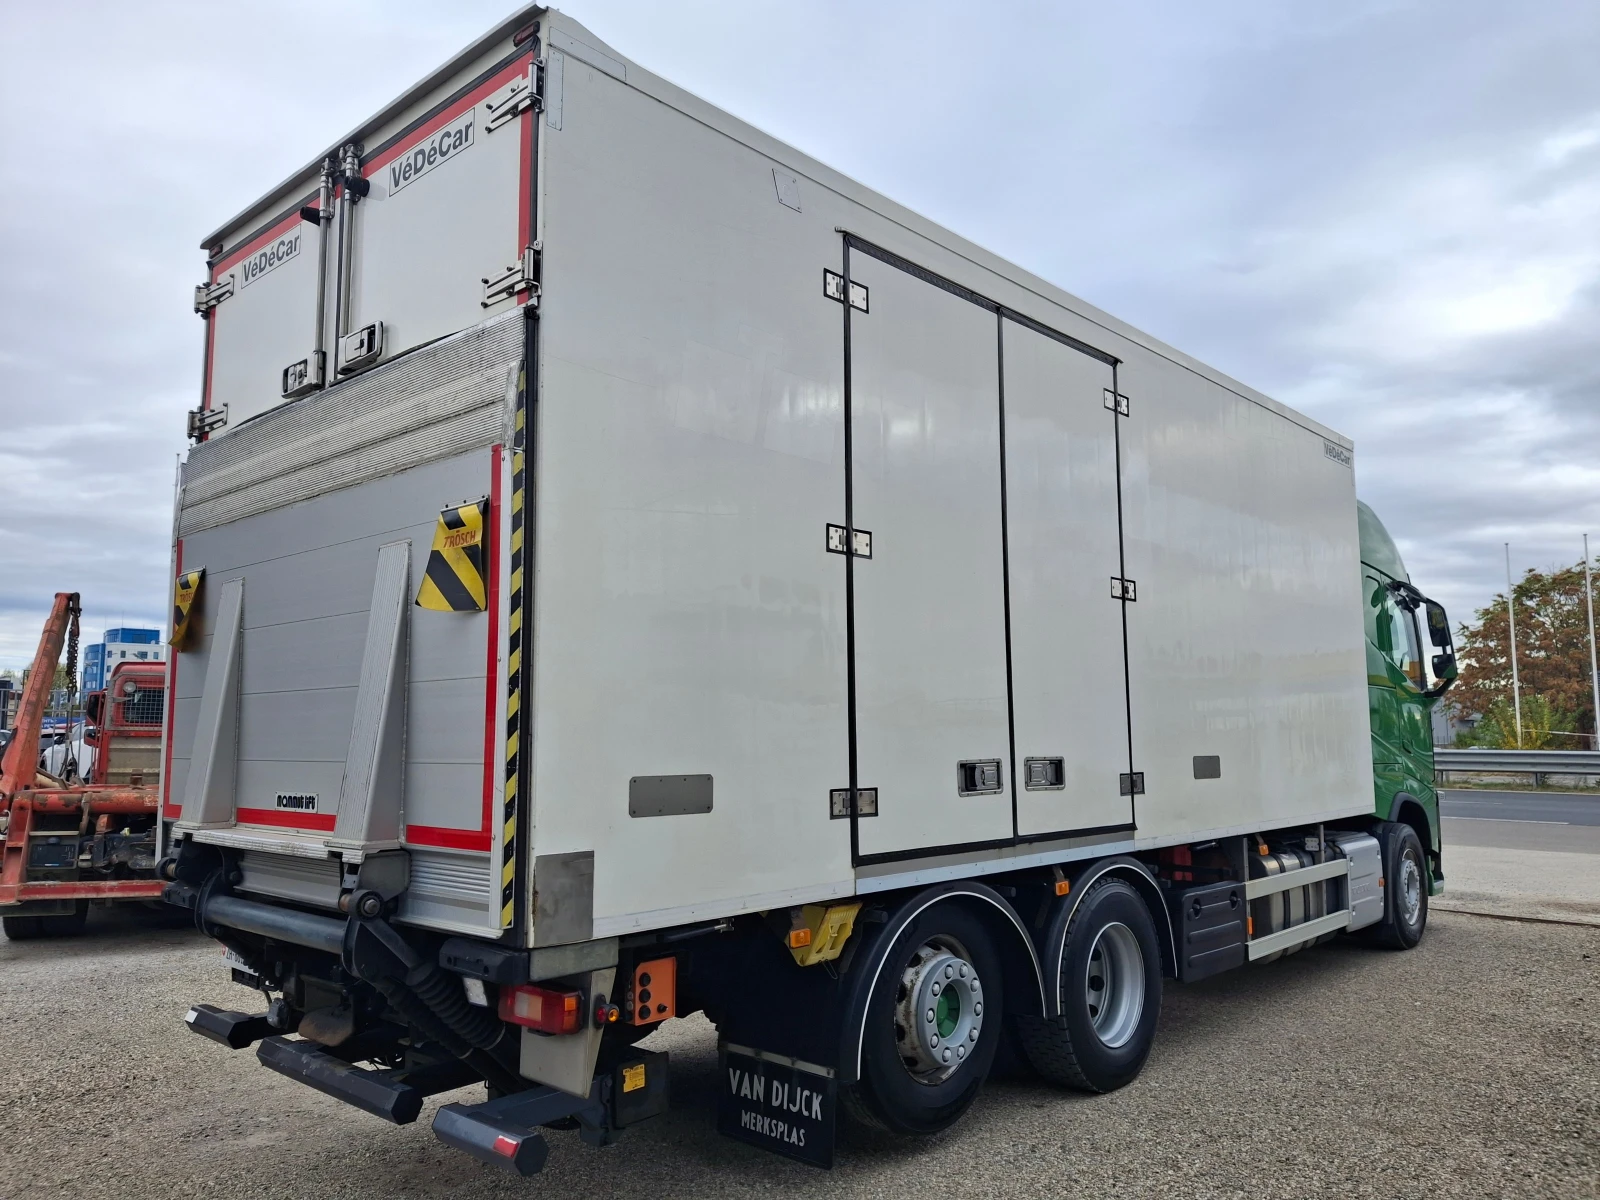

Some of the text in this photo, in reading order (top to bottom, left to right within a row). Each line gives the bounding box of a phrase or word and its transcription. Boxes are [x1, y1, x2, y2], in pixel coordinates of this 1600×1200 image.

[391, 121, 473, 188] VéDéCar
[243, 234, 300, 282] VéDéCar
[443, 530, 476, 549] TRÖSCH
[728, 1067, 823, 1121] VAN DIJCK
[741, 1109, 806, 1147] MERKSPLAS
